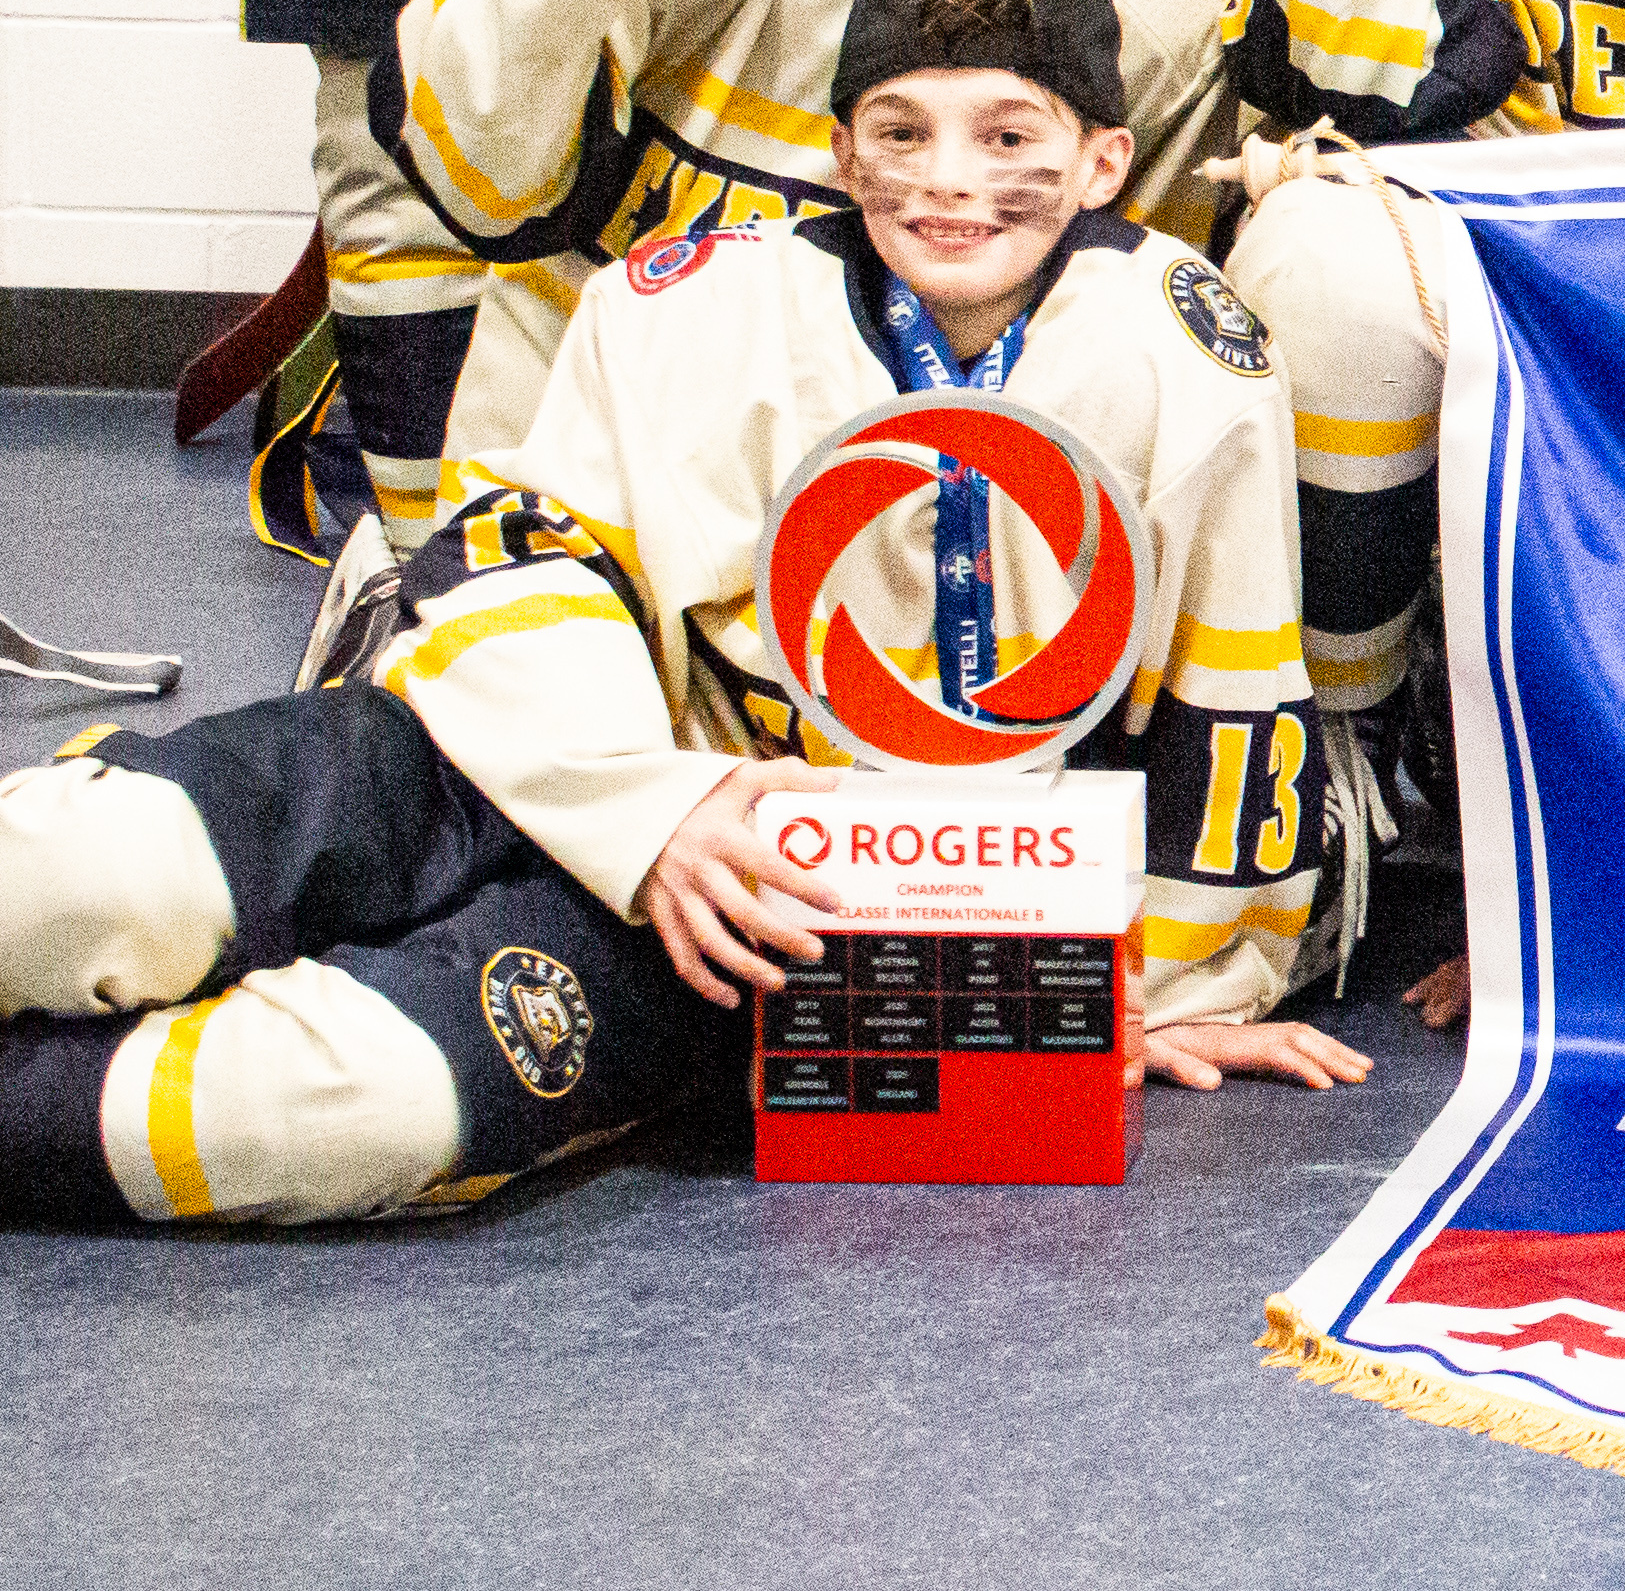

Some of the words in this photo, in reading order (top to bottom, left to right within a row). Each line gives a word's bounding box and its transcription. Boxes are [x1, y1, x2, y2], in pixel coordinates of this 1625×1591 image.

[1191, 709, 1307, 877] 13
[850, 823, 1077, 869] ROGERS
[896, 882, 985, 897] CHAMPION
[838, 905, 891, 920] CLASSE
[896, 906, 1030, 922] INTERNATIONALE
[1035, 909, 1045, 922] B
